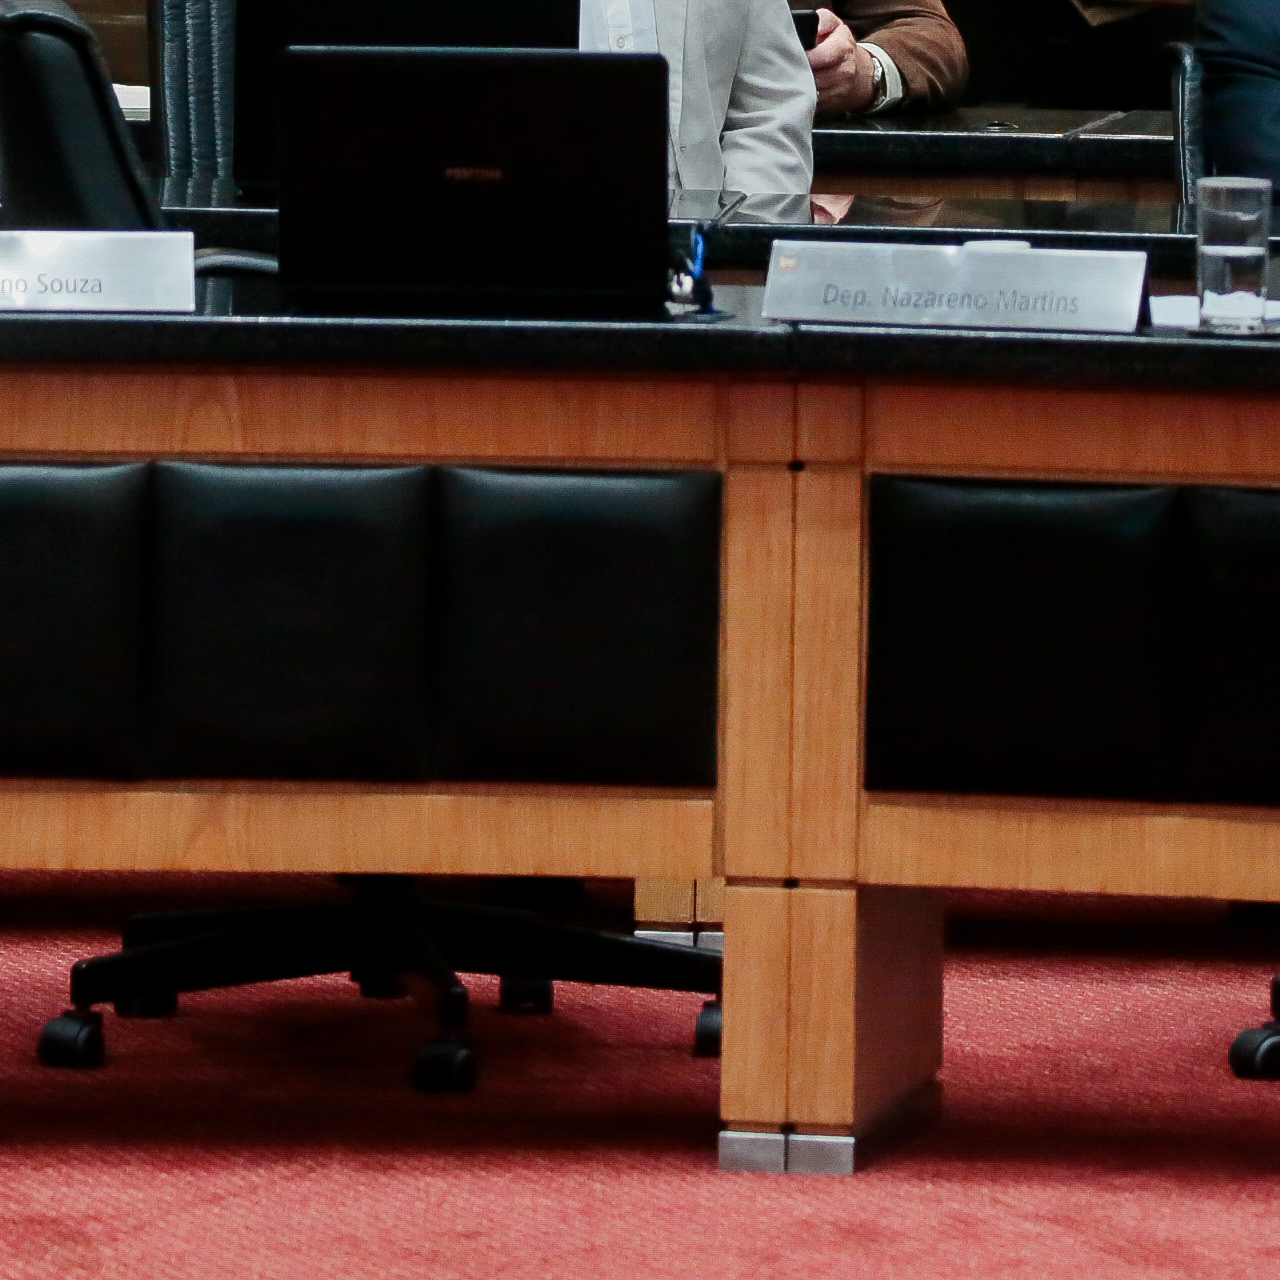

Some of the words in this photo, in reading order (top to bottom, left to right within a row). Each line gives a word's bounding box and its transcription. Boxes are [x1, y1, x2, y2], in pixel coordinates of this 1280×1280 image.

[36, 272, 103, 294] Souza
[821, 283, 871, 309] Dep.
[881, 285, 987, 312] Nazareno
[995, 288, 1081, 314] Martins
